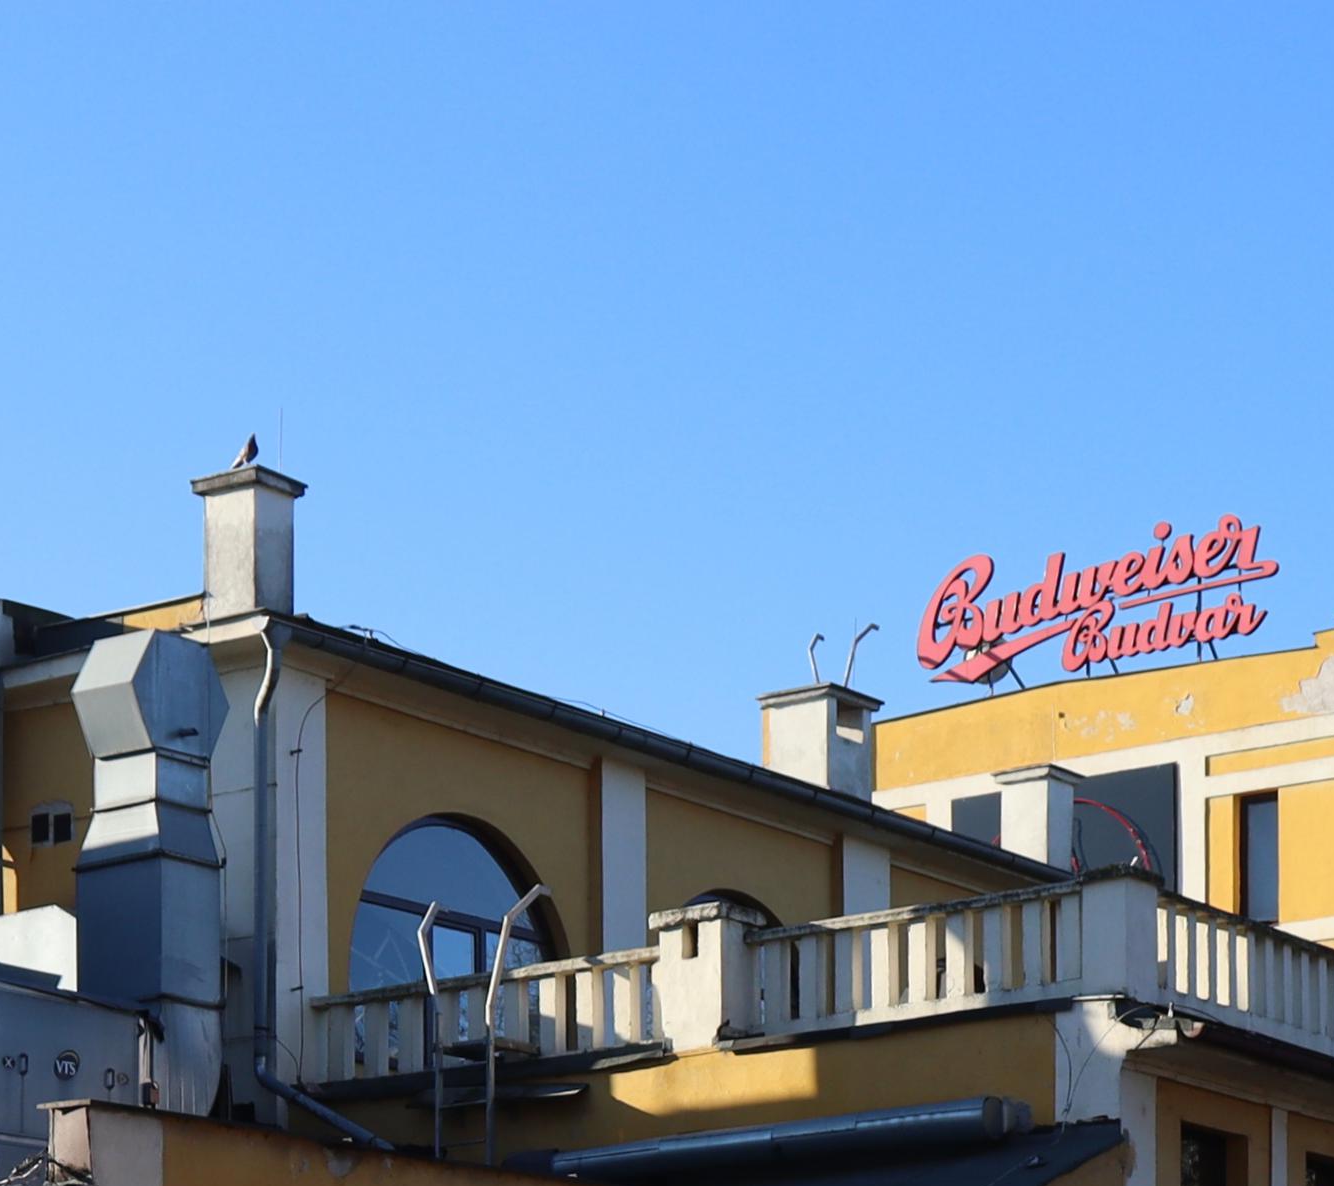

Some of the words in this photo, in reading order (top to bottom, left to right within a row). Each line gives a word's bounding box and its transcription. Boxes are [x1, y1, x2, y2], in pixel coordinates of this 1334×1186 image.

[917, 514, 1279, 670] Budweiser
[1062, 594, 1267, 672] Budvar
[56, 1060, 76, 1076] VTS
